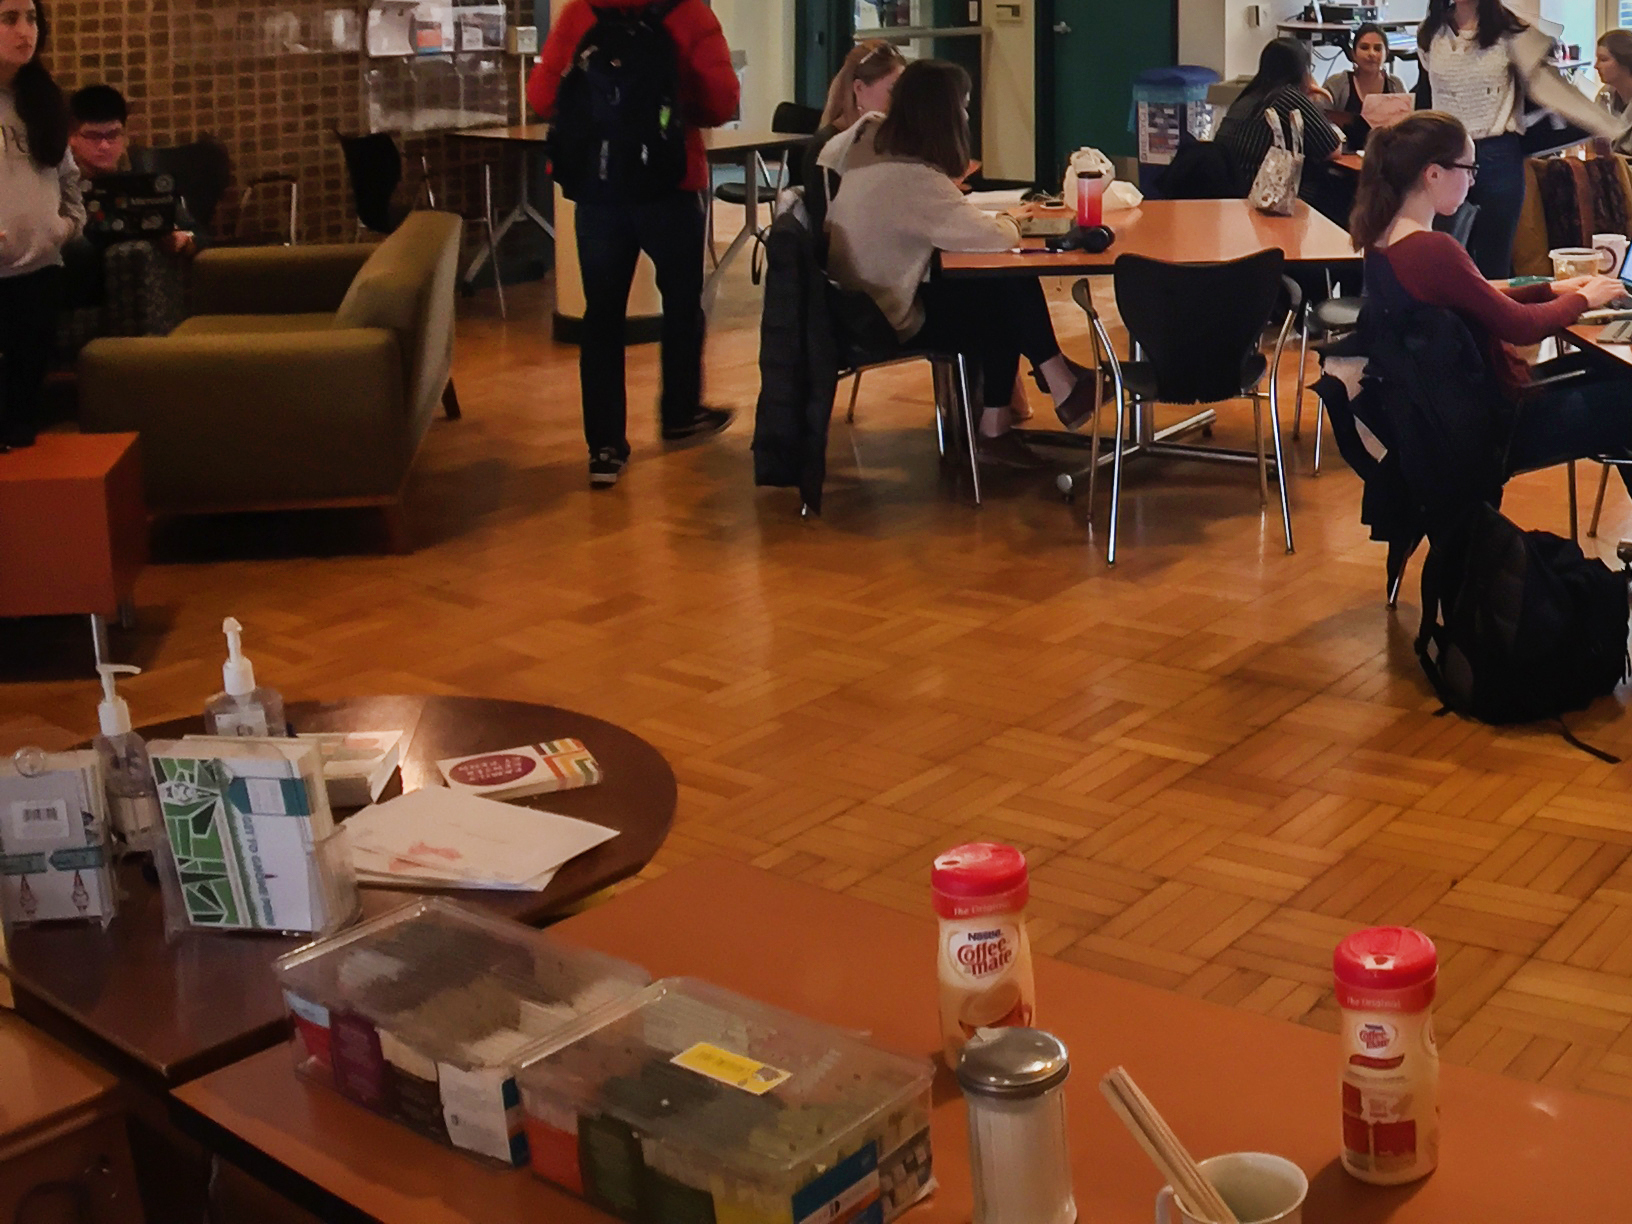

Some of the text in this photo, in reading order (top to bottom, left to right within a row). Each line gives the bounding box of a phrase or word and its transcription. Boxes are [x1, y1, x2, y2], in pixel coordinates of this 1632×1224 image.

[954, 907, 969, 916] The
[958, 939, 1007, 966] Coffee
[972, 950, 1012, 975] mate
